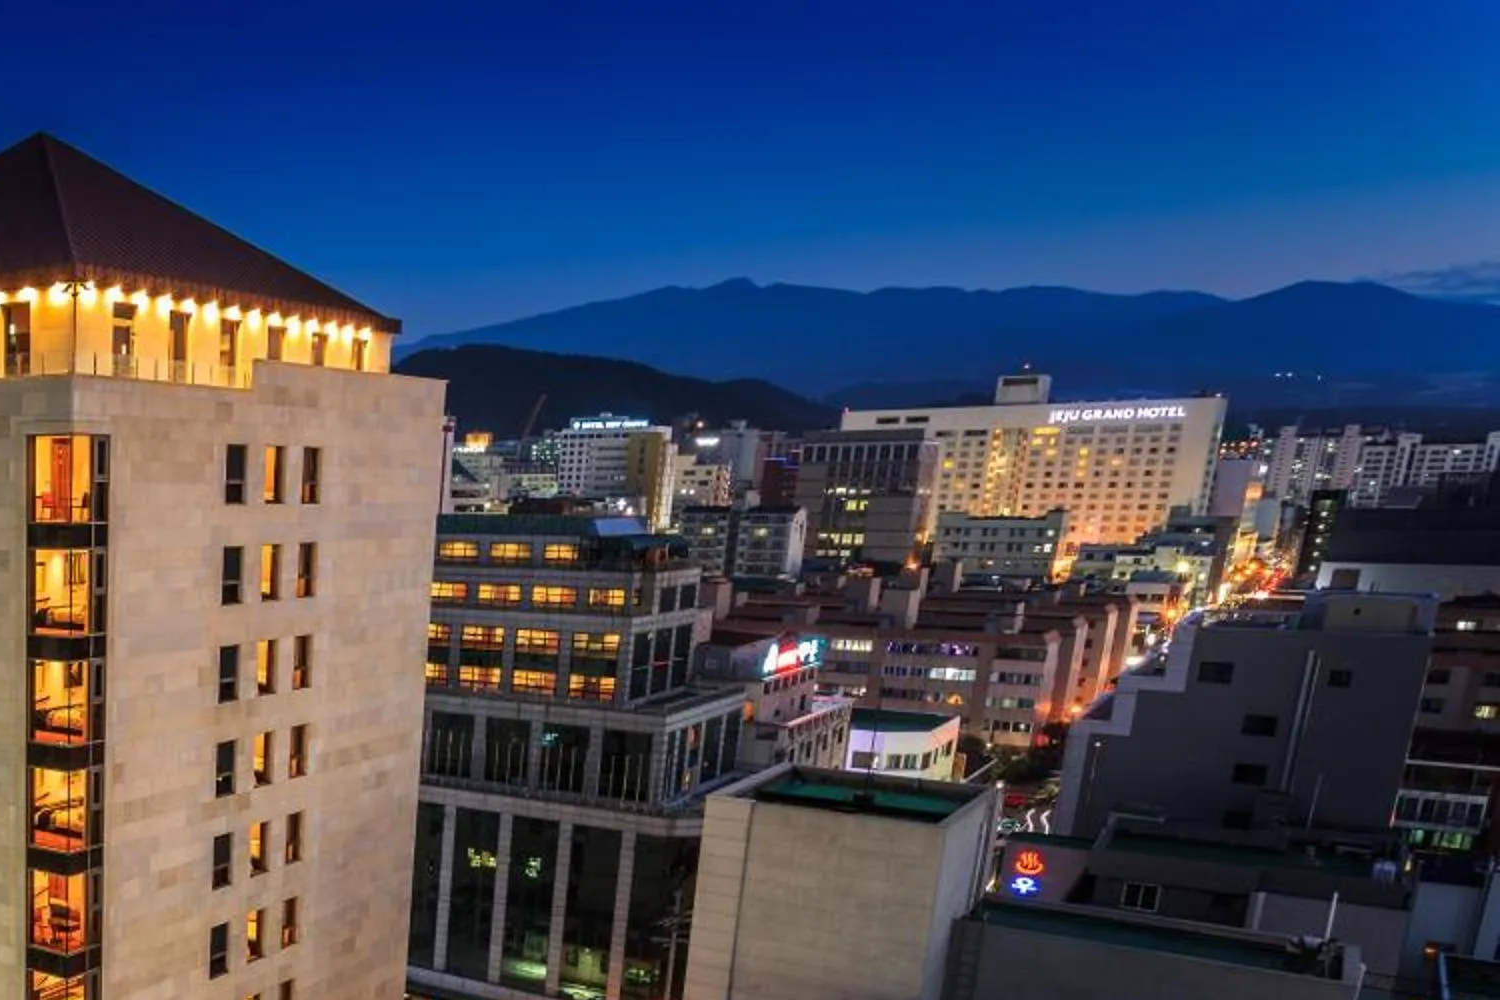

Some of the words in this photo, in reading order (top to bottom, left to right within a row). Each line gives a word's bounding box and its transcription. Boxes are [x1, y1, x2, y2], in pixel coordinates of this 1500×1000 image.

[1048, 409, 1081, 424] JEJU
[1081, 408, 1135, 421] GRAND
[1137, 406, 1187, 419] HOTEL
